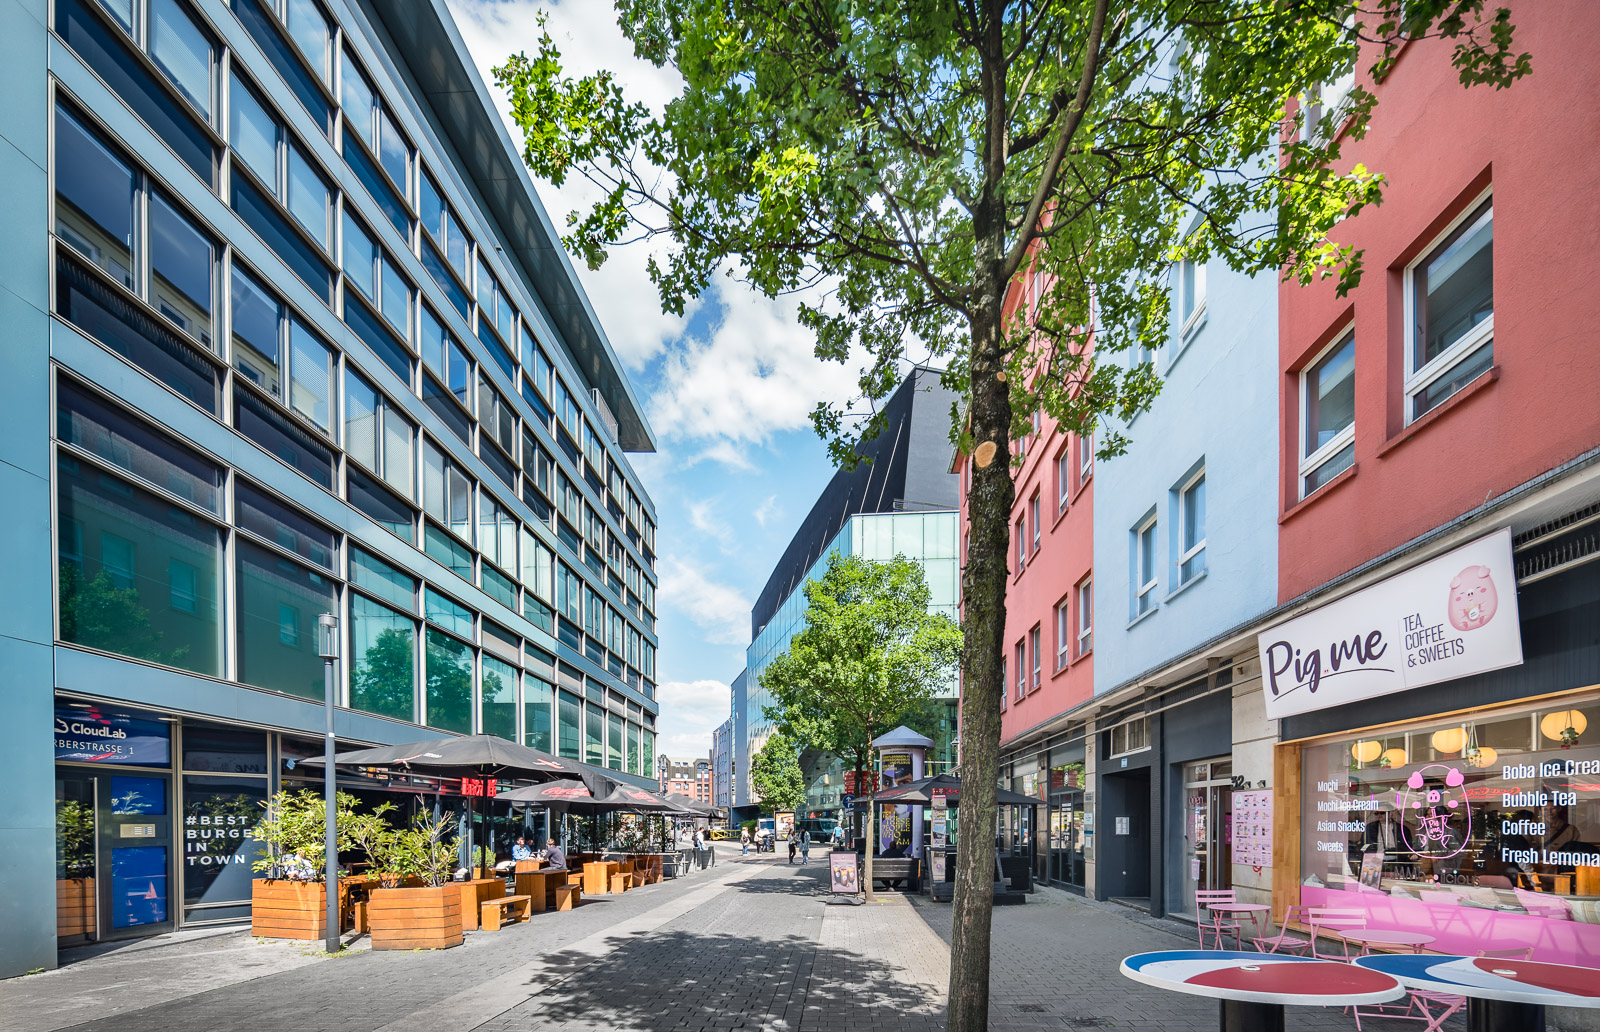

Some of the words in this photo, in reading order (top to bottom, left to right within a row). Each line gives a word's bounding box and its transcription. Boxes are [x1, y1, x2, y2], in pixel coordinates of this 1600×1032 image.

[1403, 612, 1424, 632] TEA,
[1405, 623, 1445, 651] COFFEE
[1407, 653, 1417, 668] &
[1418, 637, 1465, 665] SWEETS
[1266, 640, 1321, 695] Pig
[1330, 630, 1388, 672] me
[71, 723, 127, 739] CloudLab
[129, 746, 134, 755] 1
[1502, 763, 1536, 780] Boba
[1540, 762, 1561, 778] Ice
[1565, 759, 1600, 776] Crea
[1231, 775, 1244, 790] 32
[1317, 779, 1339, 792] Mochi
[1317, 800, 1338, 812] Mochi
[1339, 799, 1351, 811] Ice
[1353, 799, 1379, 811] Cream
[1502, 790, 1548, 808] Bubble
[1551, 790, 1577, 806] Tea
[186, 815, 248, 825] #BEST
[1317, 820, 1337, 832] Asian
[1337, 819, 1366, 832] Snacks
[1502, 819, 1546, 836] Coffee
[187, 842, 207, 852] IN
[1317, 840, 1344, 852] Sweets
[186, 854, 246, 866] TOWN
[1501, 847, 1539, 864] Fresh
[1542, 849, 1600, 867] Lemona
